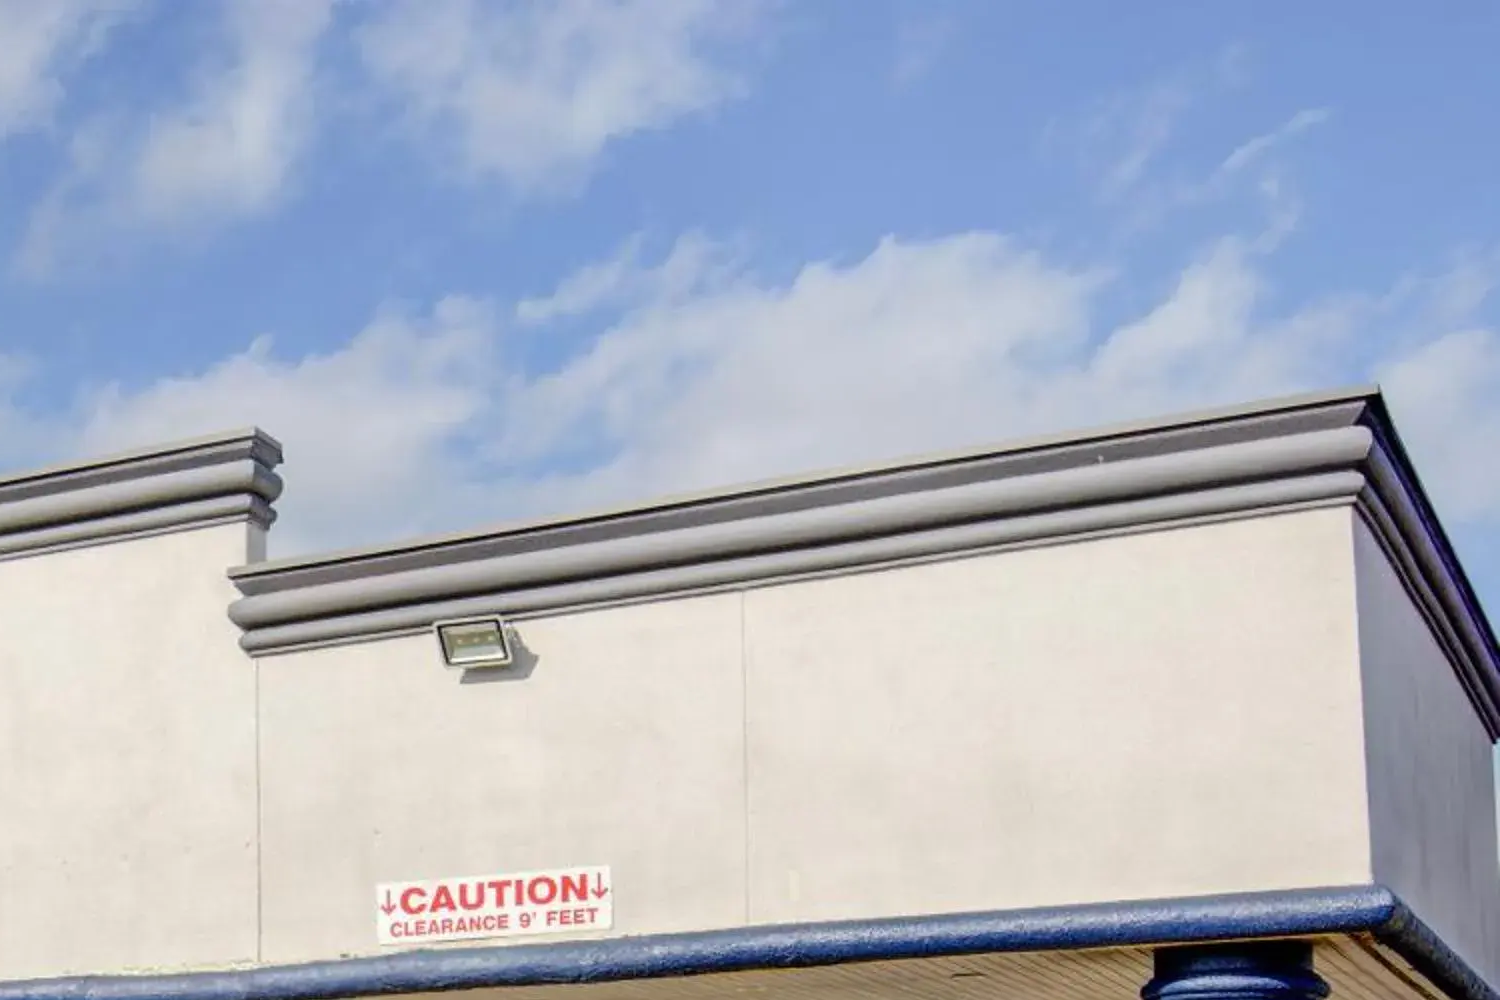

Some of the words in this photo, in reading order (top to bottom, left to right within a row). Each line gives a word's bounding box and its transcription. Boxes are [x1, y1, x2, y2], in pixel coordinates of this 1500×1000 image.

[400, 874, 588, 915] CAUTION
[390, 914, 509, 938] CLEARANCE
[519, 912, 537, 929] 9'
[546, 908, 599, 926] FEET
